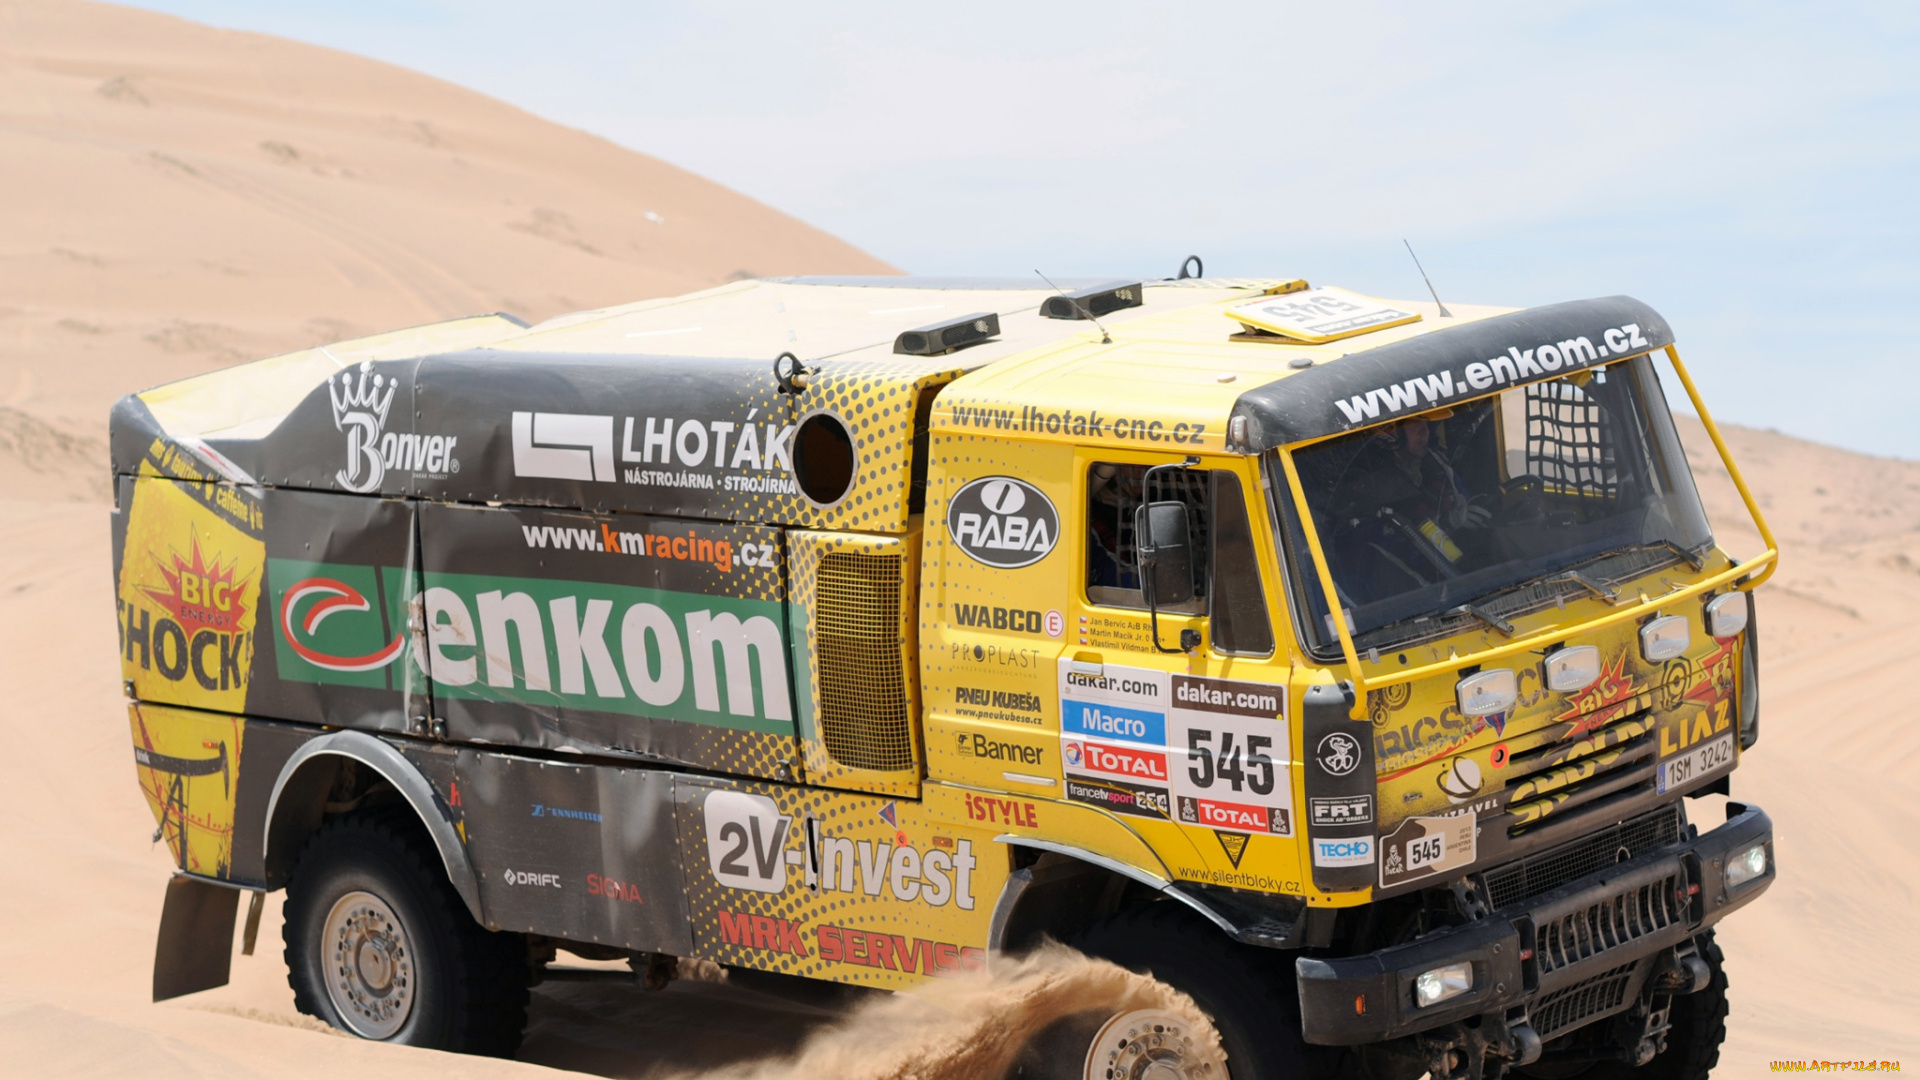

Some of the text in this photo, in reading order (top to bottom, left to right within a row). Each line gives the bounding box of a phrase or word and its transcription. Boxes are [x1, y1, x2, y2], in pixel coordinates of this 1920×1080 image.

[1334, 323, 1648, 424] www.enkom.cz
[622, 409, 797, 471] LHOTÁK
[952, 404, 1206, 445] www.lhotak-cnc.cz
[624, 469, 798, 495] NÁSTROJÁRNA STROJÍRNA
[216, 487, 249, 523] caffeine
[522, 523, 775, 571] www.kmracing.cz
[955, 512, 1052, 552] RABA
[180, 569, 231, 613] BIG
[181, 605, 232, 628] ENERGY
[954, 603, 1042, 634] WABCO
[1089, 617, 1103, 626] Jan
[1089, 628, 1112, 638] Martin
[1090, 639, 1119, 650] Vlastimil
[1121, 642, 1149, 653] Vildman
[409, 586, 793, 721] enkom
[951, 643, 1040, 669] PROPLAST
[955, 687, 1042, 713] PNEU KUBEŠA
[1176, 682, 1278, 712] dakar.com
[1579, 675, 1619, 722] BIG
[955, 707, 1043, 725] www.pneukubesa.cz
[1082, 707, 1147, 737] Macro
[1660, 698, 1730, 758] LIAZ
[973, 733, 1044, 765] Banner
[1086, 745, 1165, 777] TOTAL
[1187, 728, 1275, 795] 545
[1669, 755, 1692, 785] 1SM
[1700, 739, 1728, 772] 3242
[546, 807, 604, 823] ENNHEISER
[965, 793, 1039, 829] iSTYLE
[1200, 803, 1266, 827] TOTAL
[1314, 802, 1368, 818] FRT
[1412, 837, 1441, 865] 545
[517, 871, 562, 889] DRIFT
[586, 873, 644, 904] SIGMA
[1178, 866, 1300, 893] www.silentbloky.cz
[718, 910, 809, 957] MRK
